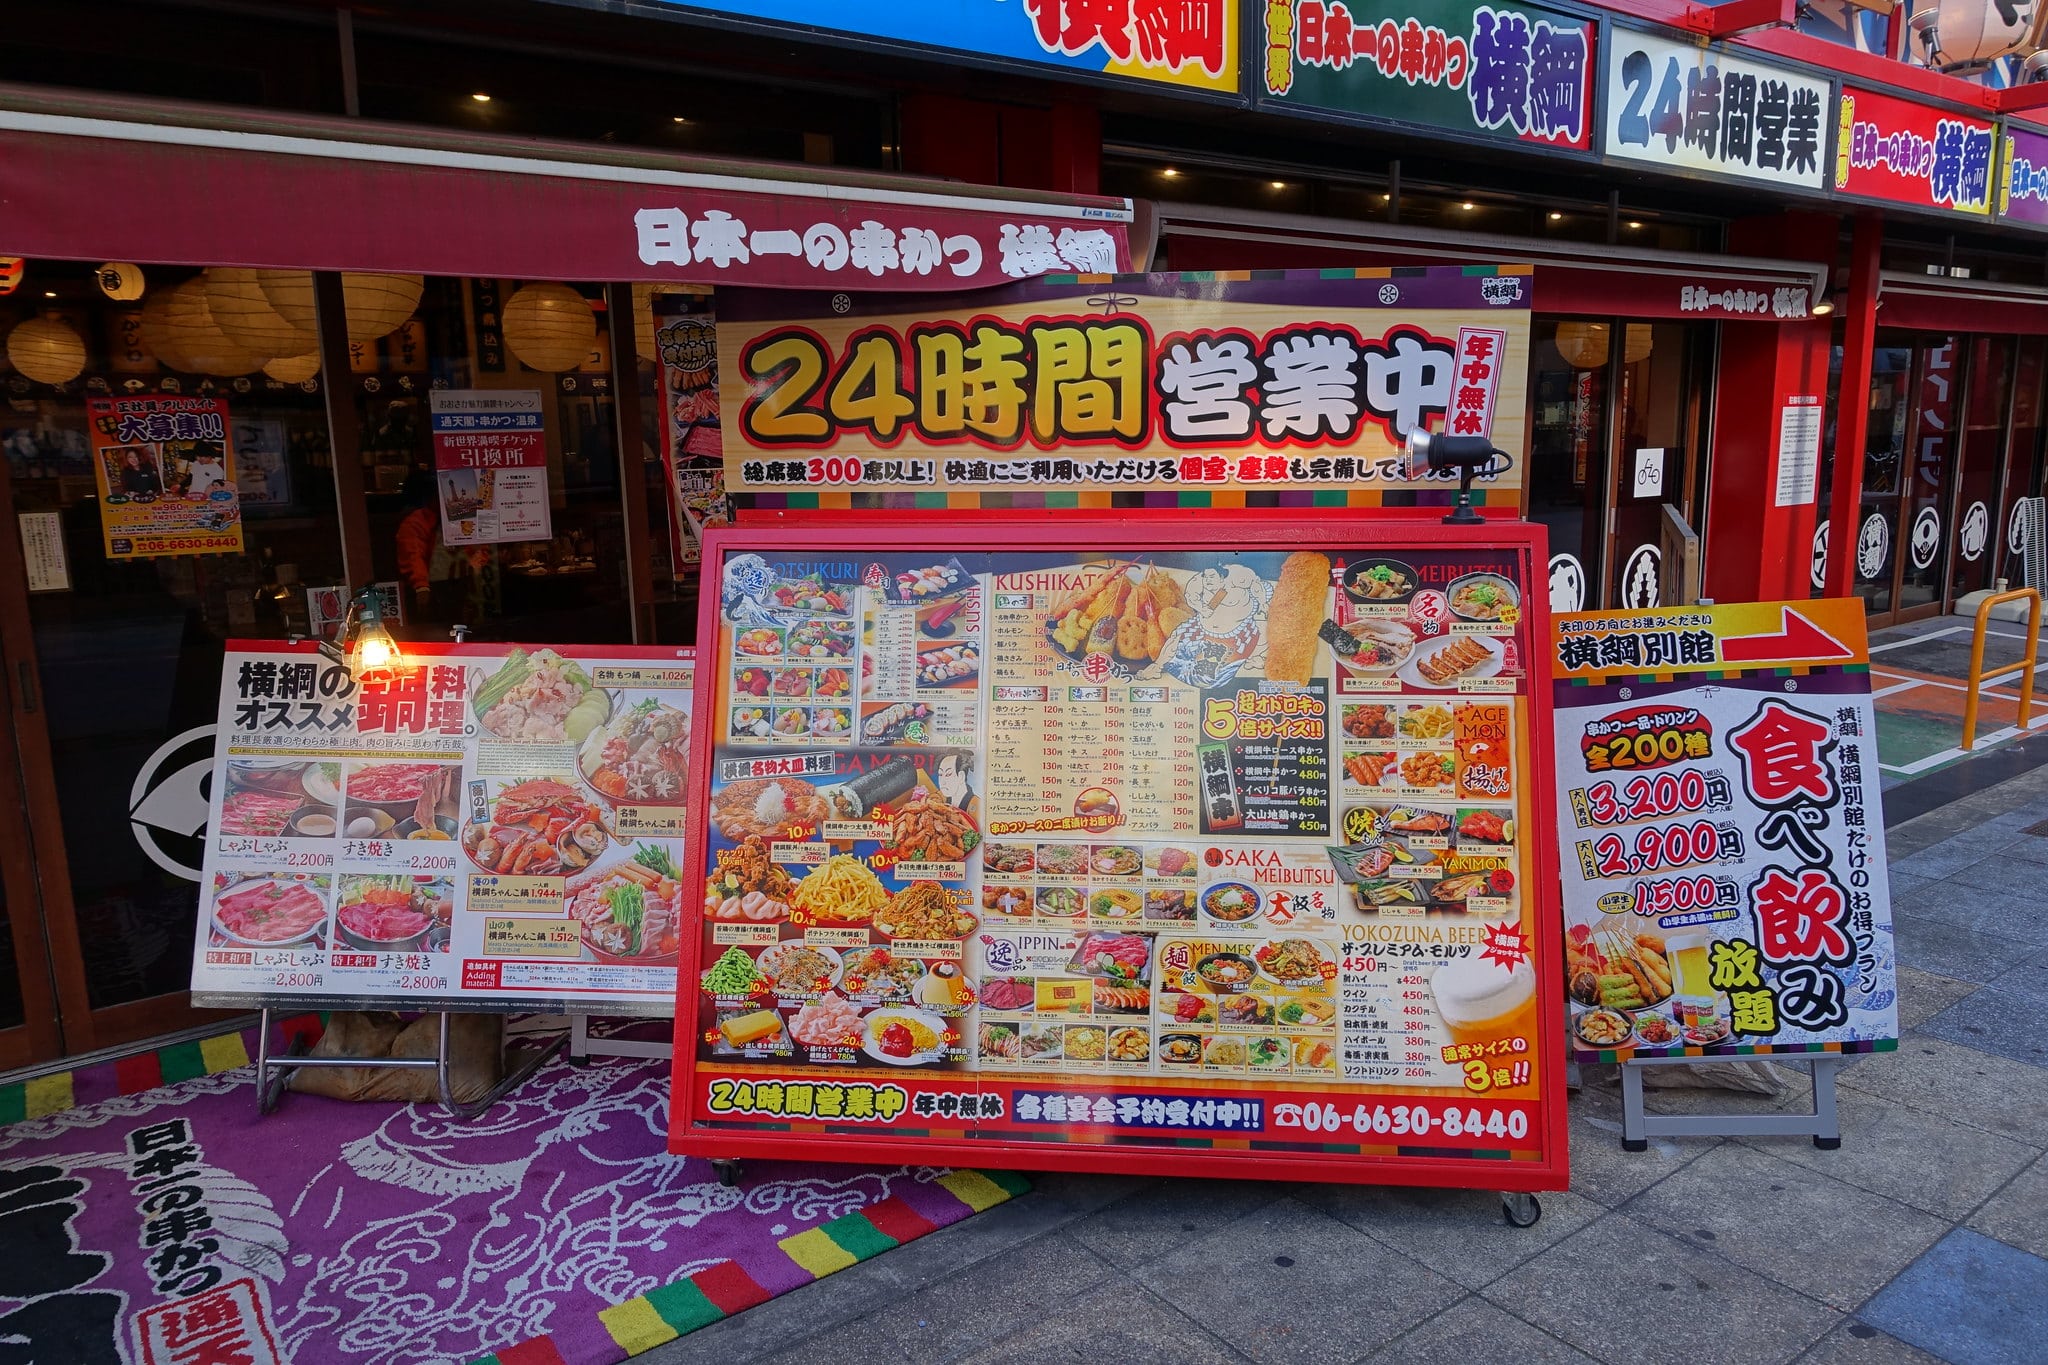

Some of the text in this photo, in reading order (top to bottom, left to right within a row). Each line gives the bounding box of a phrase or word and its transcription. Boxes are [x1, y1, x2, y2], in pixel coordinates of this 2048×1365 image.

[1296, 1, 1469, 90] 日本一の串かつ
[1469, 6, 1588, 143] 横綱
[1618, 50, 1820, 175] 24時間営業
[1852, 122, 1933, 178] 日本一の串かつ
[1931, 119, 1993, 208] 横綱
[634, 207, 1118, 279] 日本一の串かつ 横綱
[1483, 284, 1518, 299] 横綱
[1680, 286, 1768, 313] 日本一の串かつ
[741, 316, 1456, 448] 24時間営業中
[1453, 335, 1493, 435] 年中無休
[118, 413, 224, 442] 大募集!!
[441, 415, 537, 426] 通天閣・串かつ・温泉
[444, 435, 537, 447] 新世界満喫チケット
[461, 448, 524, 466] 引換所
[744, 459, 936, 484] 総席数300席以上!
[148, 538, 238, 550] 06-6630-8440
[772, 562, 858, 579] OTSUKURI
[996, 574, 1104, 590] KUSHIKAT
[1421, 593, 1438, 634] 名物
[1559, 613, 1713, 633] 矢印の方向にお進みください
[1559, 630, 1716, 671] 横綱別館
[238, 661, 356, 700] 横綱の
[598, 670, 614, 680] 名物
[617, 670, 640, 680] もつ鍋
[356, 665, 427, 734] 鍋
[1237, 691, 1323, 715] 超オドロキの
[234, 702, 353, 731] オススメ
[1044, 706, 1064, 714] 120円
[1104, 706, 1124, 714] 150円
[1471, 708, 1506, 722] AGE
[1043, 720, 1063, 728] 120円
[1104, 720, 1124, 728] 150円
[1204, 698, 1237, 739] 5
[1586, 709, 1699, 738] 串かつ・一品・ドリンク
[1838, 706, 1860, 738] 横綱
[1238, 719, 1324, 739] 倍サイズ!!
[1463, 725, 1506, 738] MON
[946, 736, 975, 745] MAKI
[1043, 734, 1063, 742] 120円
[1104, 734, 1124, 743] 180円
[1043, 748, 1062, 756] 130円
[1102, 749, 1124, 757] 200円
[1585, 730, 1712, 772] 全200種
[724, 756, 831, 779] 横綱名物大皿料理
[1043, 762, 1062, 770] 130円
[1103, 763, 1124, 771] 210円
[1042, 777, 1062, 785] 150円
[1102, 777, 1124, 785] 250円
[1042, 791, 1061, 799] 120円
[1588, 768, 1733, 824] 3,200円
[620, 808, 637, 818] 名物
[1041, 805, 1061, 813] 150円
[1572, 789, 1589, 826] 大人男性
[619, 819, 675, 829] 横綱ちゃんこ鍋
[218, 838, 288, 853] しゃぶしゃぶ
[342, 841, 393, 857] すき焼き
[1596, 822, 1745, 877] 2,900円
[1442, 858, 1508, 870] YAKIMON
[1579, 841, 1596, 879] 大人女性
[1727, 697, 1856, 1031] 食べ飲み
[1253, 867, 1335, 884] MEIBUTSU
[1838, 744, 1878, 994] 横綱別館だけのお得プラン
[472, 877, 498, 886] 海の幸
[472, 888, 529, 898] 横綱ちゃんこ鍋
[1602, 895, 1631, 905] 小学生
[1633, 876, 1740, 916] 1,500円
[489, 920, 514, 930] 山の幸
[488, 931, 545, 941] 横綱ちゃんこ鍋
[1342, 924, 1486, 944] YOKOZUNA BEER
[1019, 937, 1059, 950] IPPIN
[1192, 943, 1221, 955] MEN
[1341, 943, 1471, 958] ザ・プレミアム・モルツ
[206, 952, 324, 966] 特上和牛 しゃぶしゃぶ
[332, 955, 431, 970] 特上和牛 すき焼き
[466, 979, 495, 987] material
[467, 972, 495, 981] Adding
[1343, 990, 1367, 999] ワイン
[1709, 939, 1781, 1037] 放題
[1344, 1006, 1376, 1014] カクテル
[1344, 1036, 1385, 1045] ハイボール
[1441, 1038, 1527, 1062] 通常サイズの
[1344, 1067, 1399, 1075] ソフトドリンク
[1464, 1060, 1531, 1091] 3倍!!
[708, 1078, 1528, 1139] 24時間営業中 年中無休 各種宴会予約受付中!! 06-6630-8440
[132, 1119, 221, 1297] 日本一の串かつ
